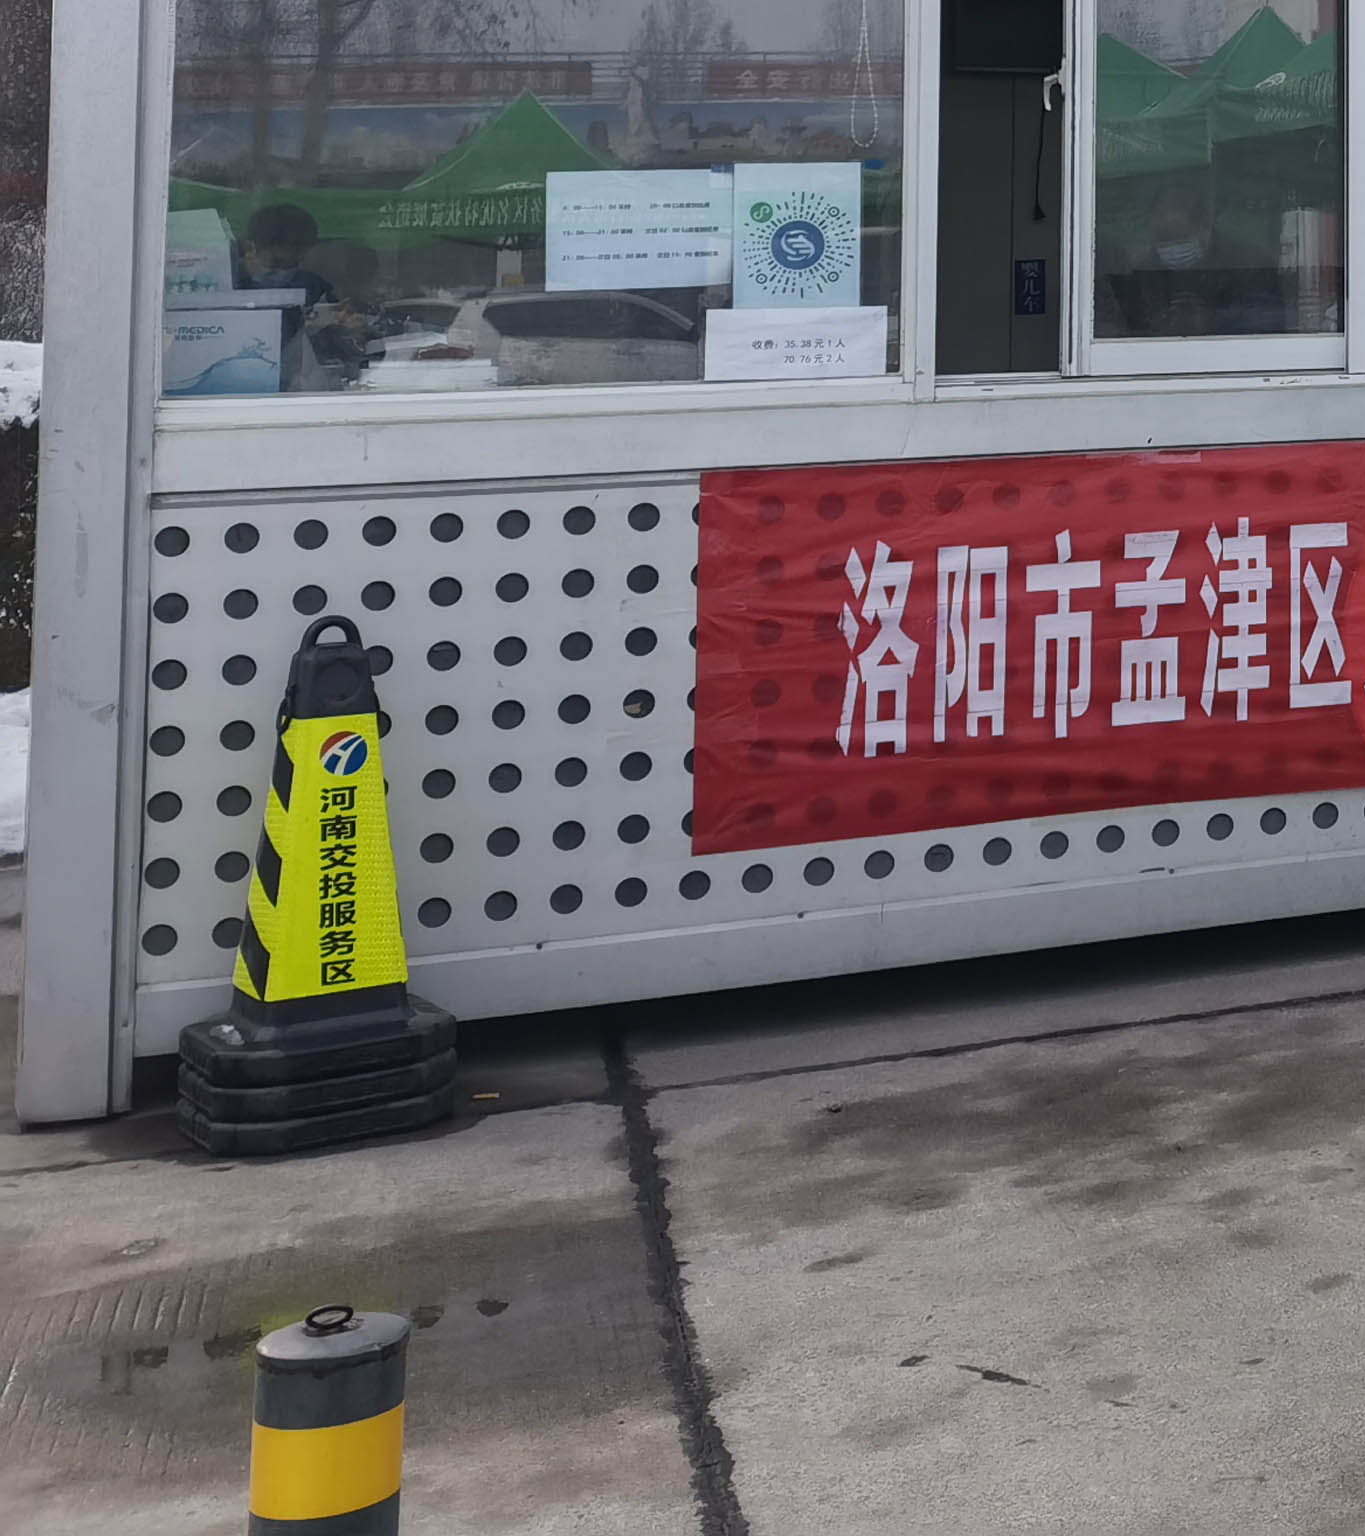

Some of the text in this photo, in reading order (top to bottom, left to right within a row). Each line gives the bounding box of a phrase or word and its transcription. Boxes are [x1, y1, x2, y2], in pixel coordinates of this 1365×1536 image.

[318, 786, 358, 986] 河南交投服务区
